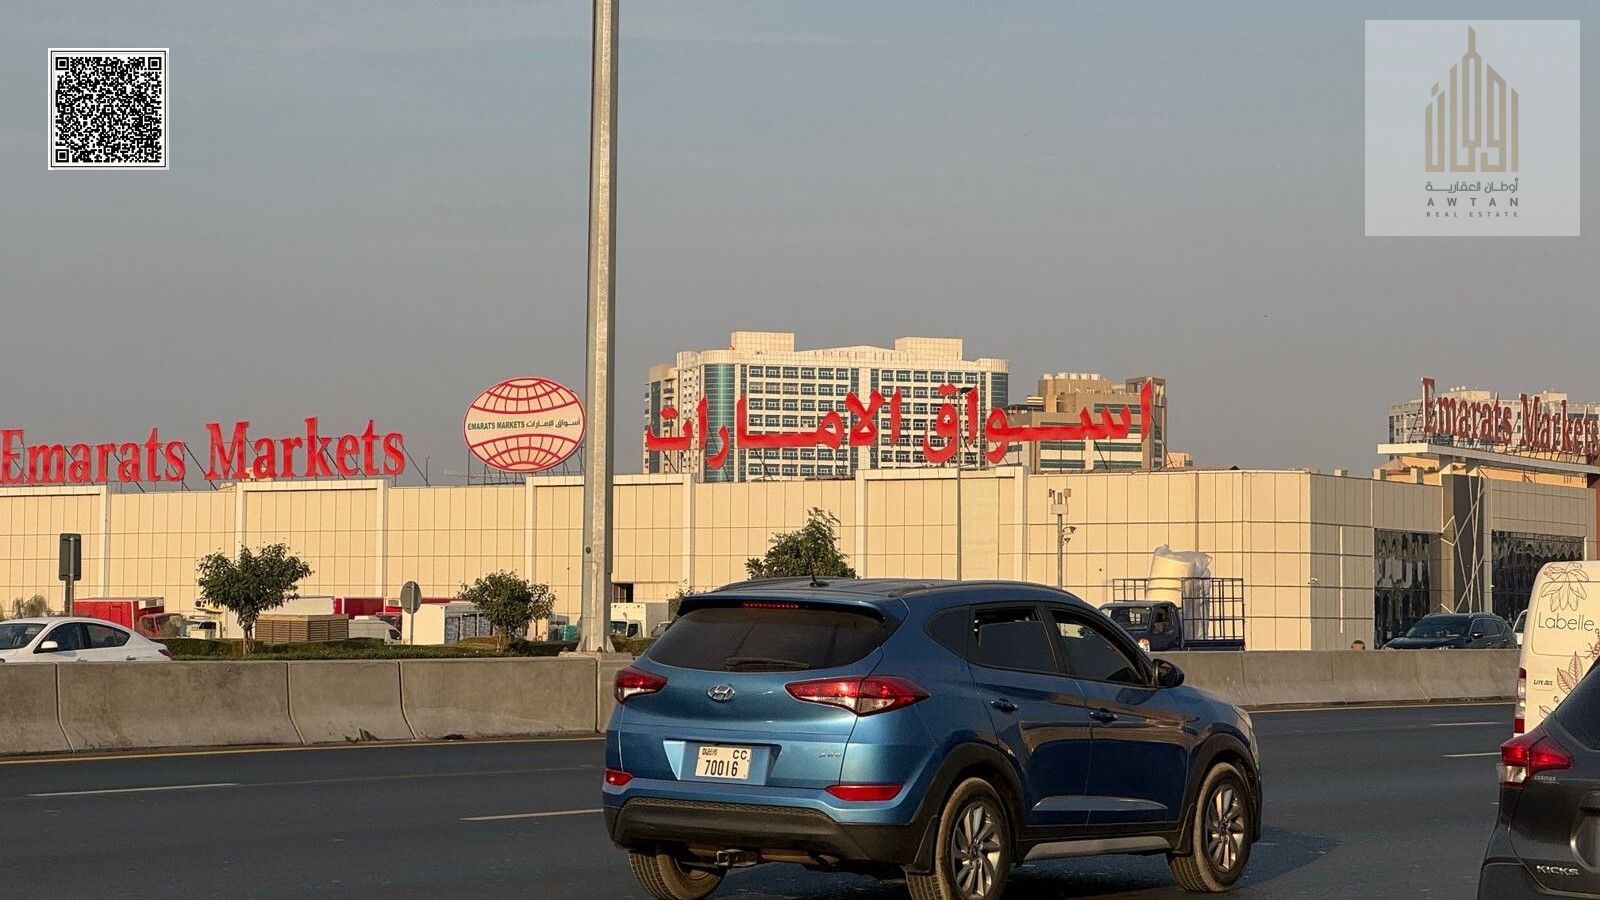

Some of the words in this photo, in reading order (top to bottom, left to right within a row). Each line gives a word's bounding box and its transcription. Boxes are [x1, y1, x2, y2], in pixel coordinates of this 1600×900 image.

[467, 421, 496, 431] EMARATS
[496, 420, 525, 429] MARKETS
[1421, 377, 1512, 445] Emarats
[1519, 393, 1600, 458] Markets
[0, 427, 186, 483] Emarats
[204, 416, 406, 480] Markets
[1538, 612, 1595, 631] Labelle
[732, 749, 748, 760] CC
[704, 759, 739, 777] 70016
[1536, 865, 1579, 876] KICKS
